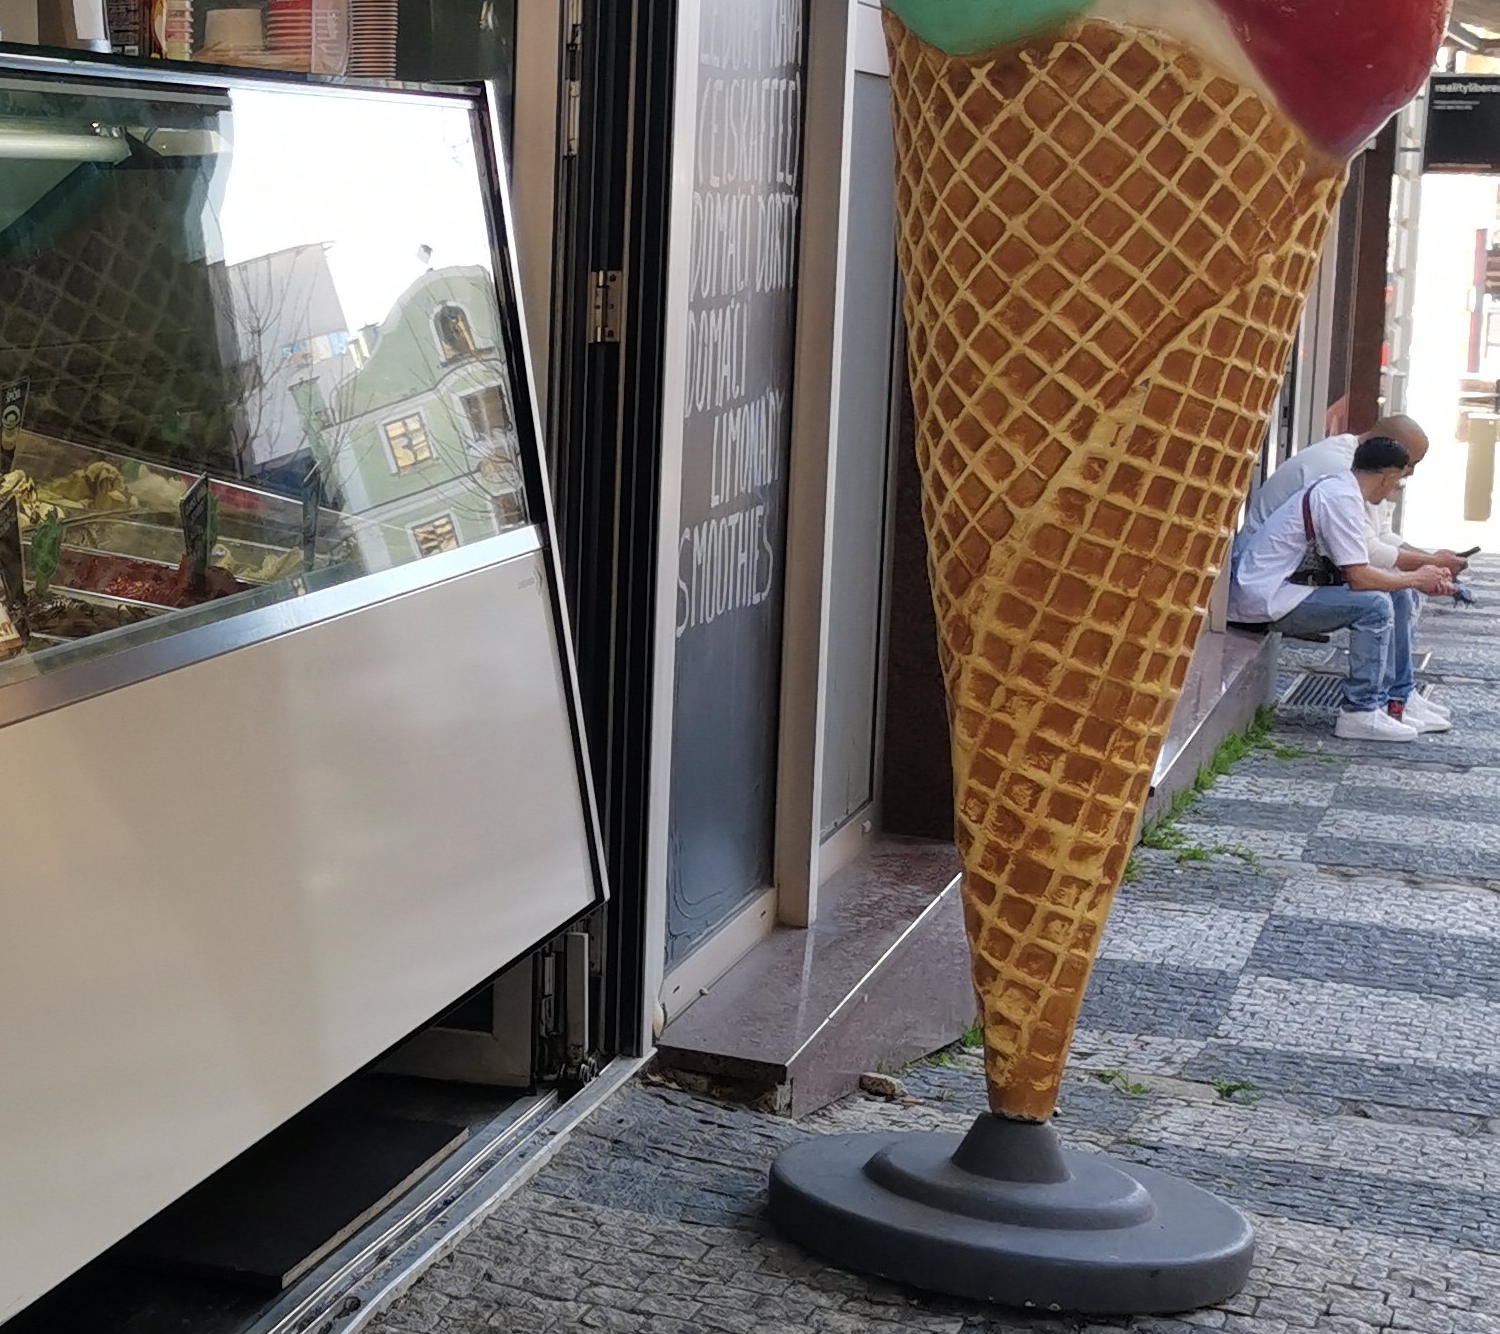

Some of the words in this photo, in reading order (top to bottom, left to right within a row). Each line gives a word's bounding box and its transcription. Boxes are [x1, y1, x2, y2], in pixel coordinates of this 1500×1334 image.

[697, 70, 801, 193] (EISKAFFEE)
[756, 190, 799, 293] DORTY
[676, 502, 773, 638] SMOOTHIES
